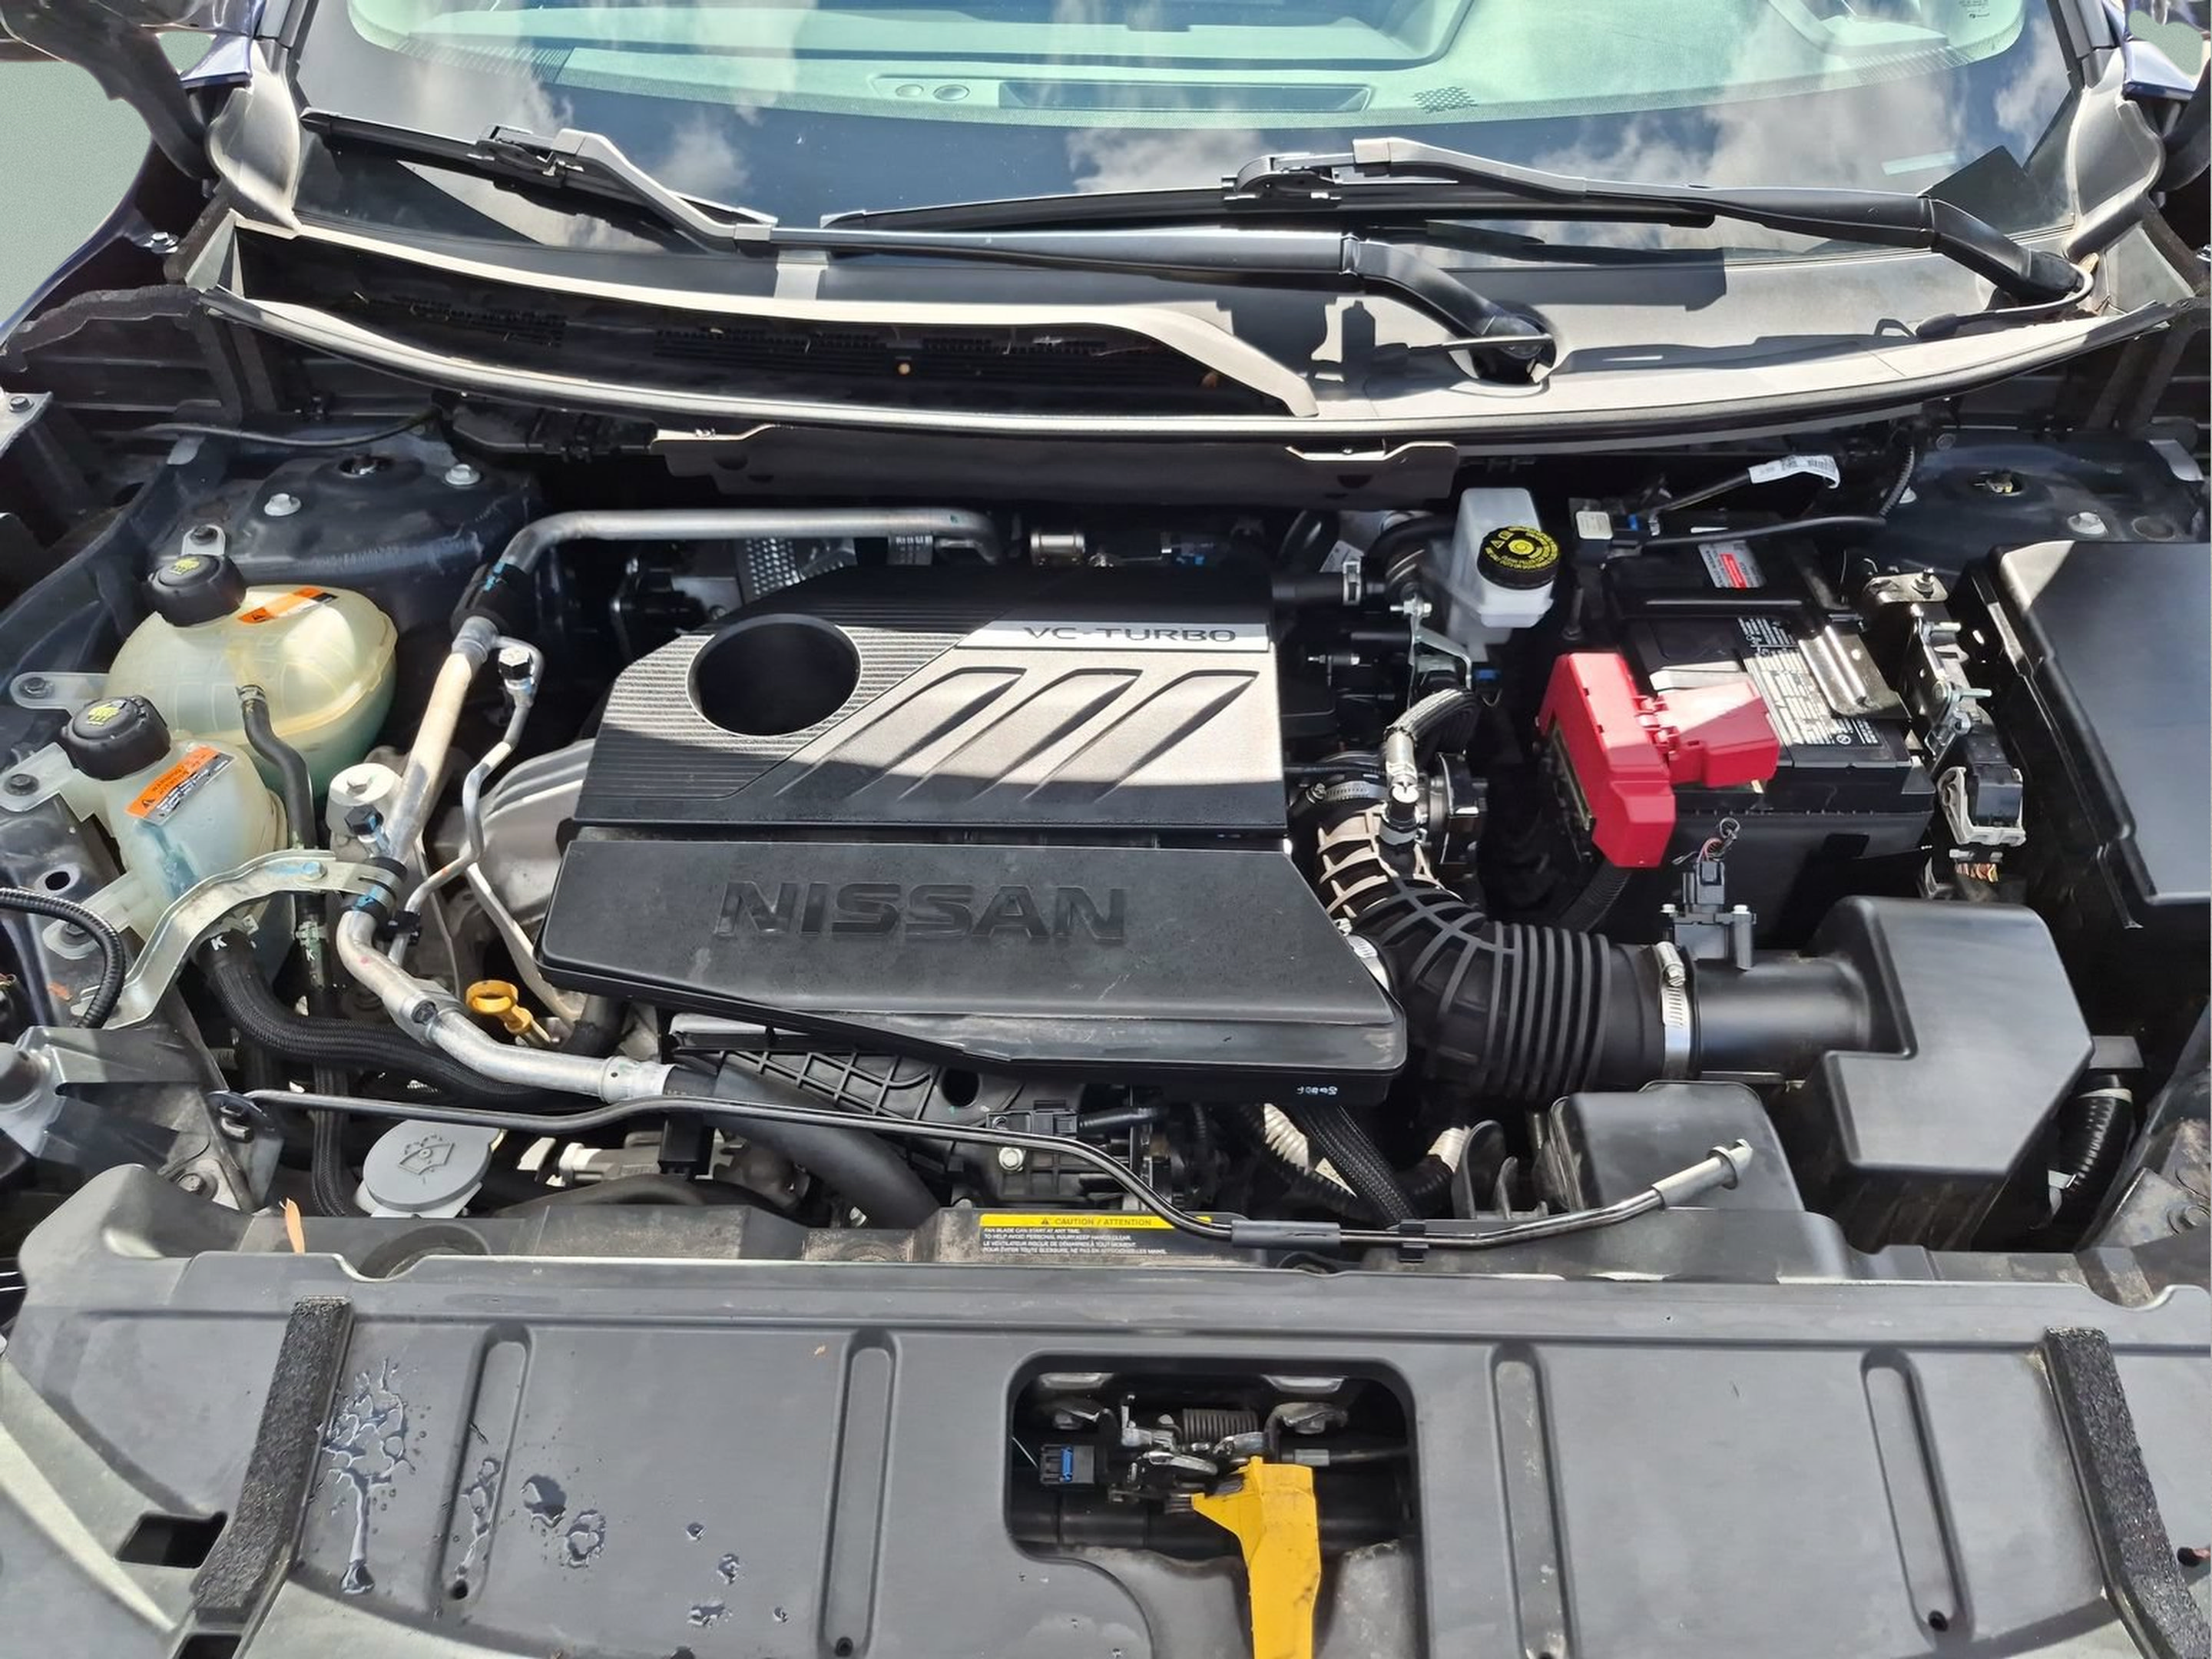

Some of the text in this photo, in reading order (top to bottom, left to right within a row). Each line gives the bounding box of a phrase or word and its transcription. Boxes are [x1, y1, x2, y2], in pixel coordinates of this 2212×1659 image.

[1023, 627, 1236, 643] VC-TURBO
[713, 880, 1128, 939] NISSAN
[210, 935, 227, 951] K
